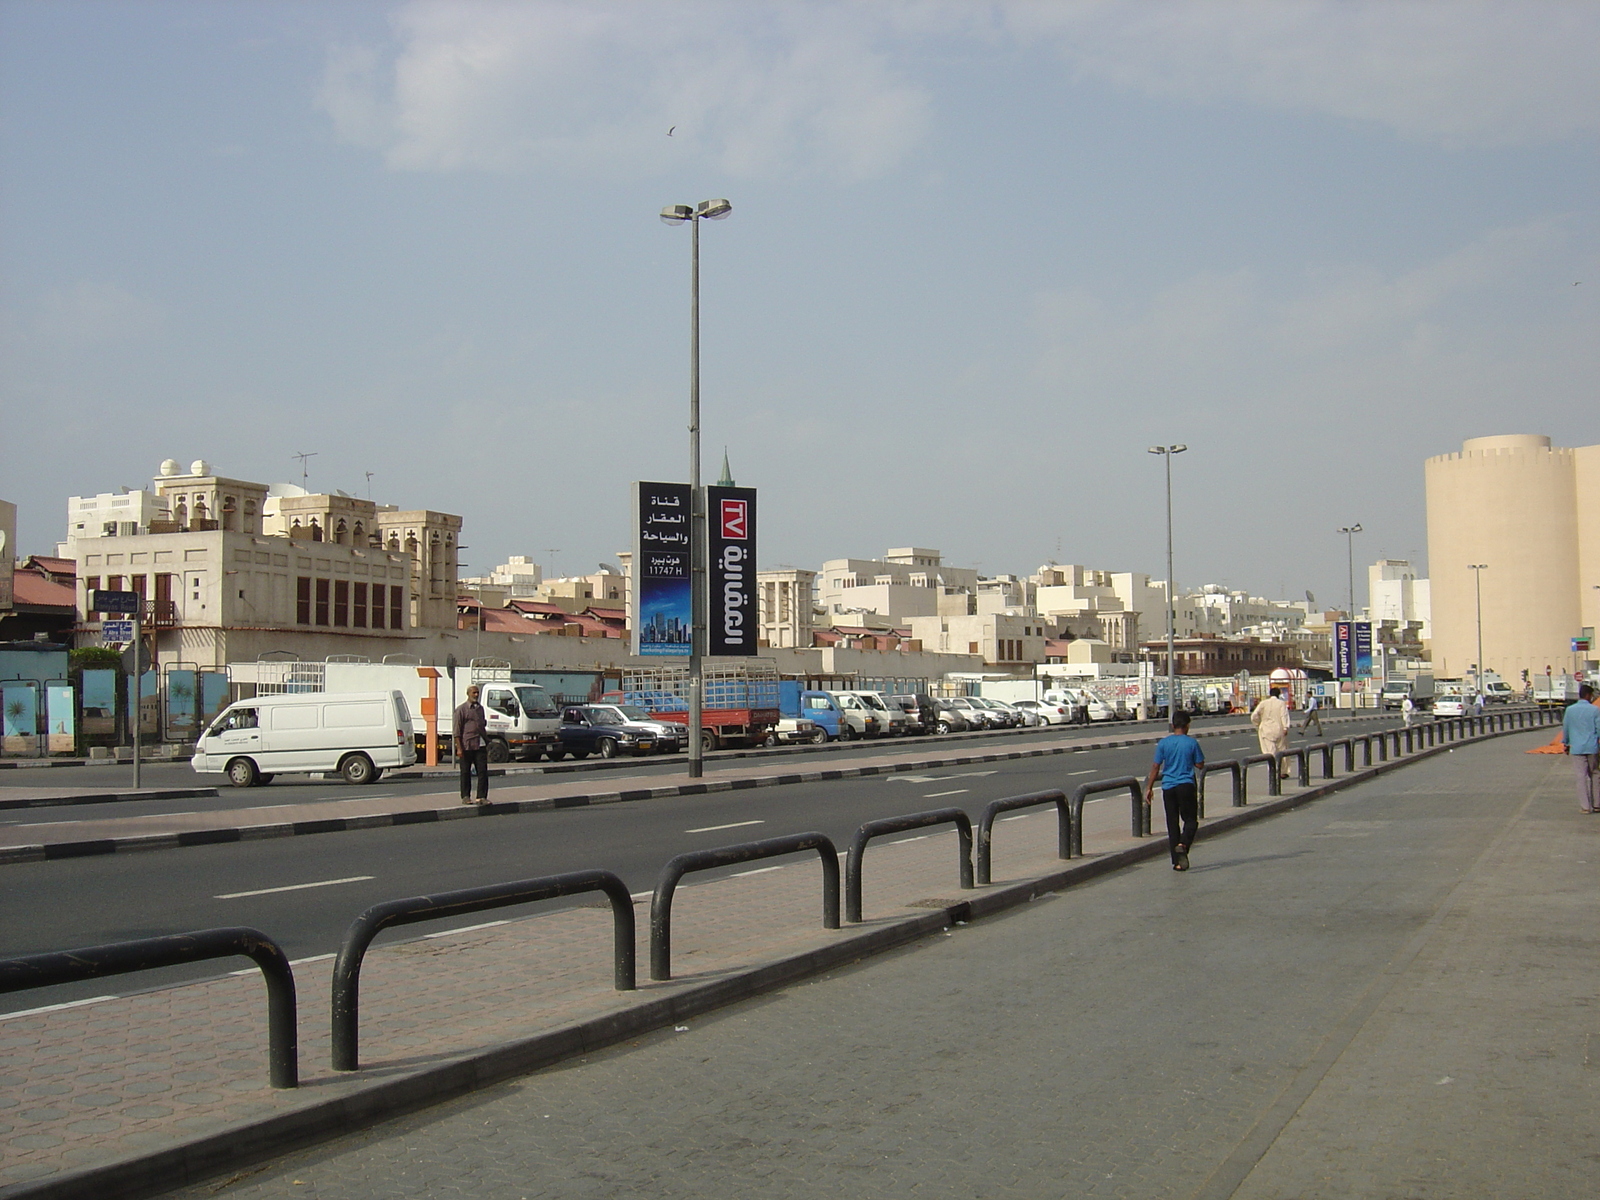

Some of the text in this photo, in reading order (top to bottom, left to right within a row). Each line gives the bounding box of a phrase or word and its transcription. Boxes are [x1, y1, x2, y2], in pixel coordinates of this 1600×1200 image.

[651, 496, 680, 506] قناة
[646, 513, 685, 524] العقار
[724, 504, 744, 536] TV
[642, 530, 688, 544] والسياحة
[650, 566, 682, 576] 11747 H
[718, 546, 748, 644] العقارية
[1340, 626, 1348, 638] TV
[1340, 640, 1348, 674] aqariya
